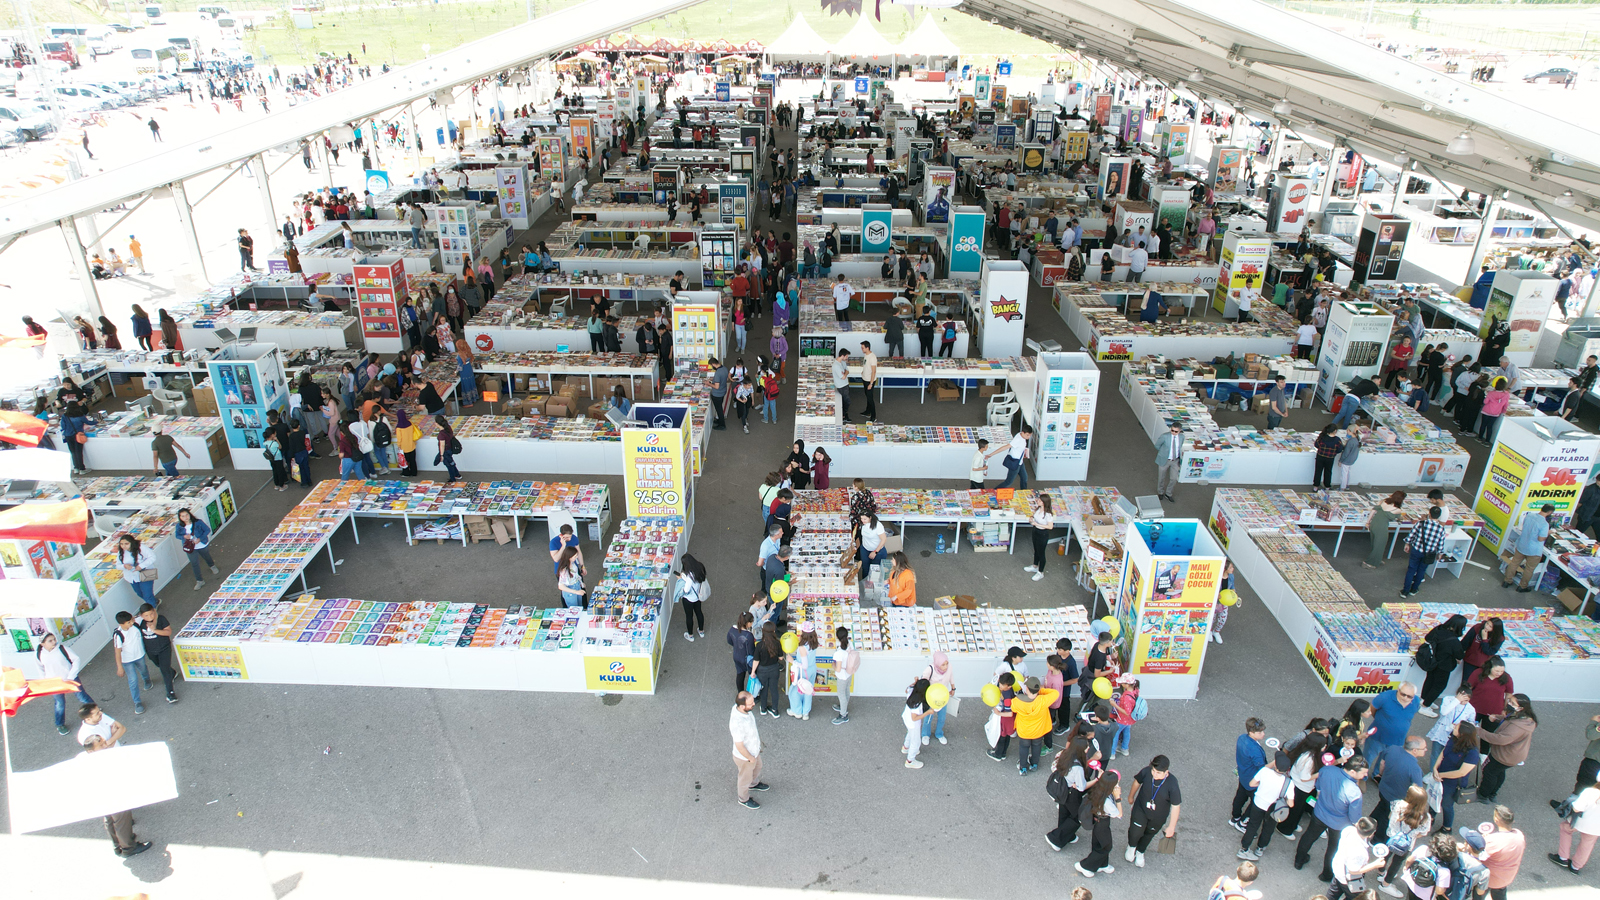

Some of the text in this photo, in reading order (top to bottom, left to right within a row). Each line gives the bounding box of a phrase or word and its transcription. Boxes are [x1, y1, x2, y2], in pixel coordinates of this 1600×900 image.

[991, 303, 1020, 314] BANG!
[1108, 343, 1128, 354] 50%
[635, 464, 673, 480] TEST
[1492, 466, 1521, 486] SINAVLARA
[1541, 467, 1577, 486] 50%
[636, 480, 674, 488] KİTAPLARI
[1492, 475, 1515, 492] HAZIRLIK
[634, 490, 679, 505] %50
[1494, 488, 1507, 500] TEST
[1484, 491, 1510, 514] KİTAPLARI
[638, 505, 677, 514] indirim
[1190, 563, 1210, 571] MAVİ
[1189, 571, 1212, 580] GÖZLÜ
[1187, 580, 1214, 589] ÇOCUK
[1314, 638, 1331, 674] 50%
[1354, 667, 1390, 685] 50%
